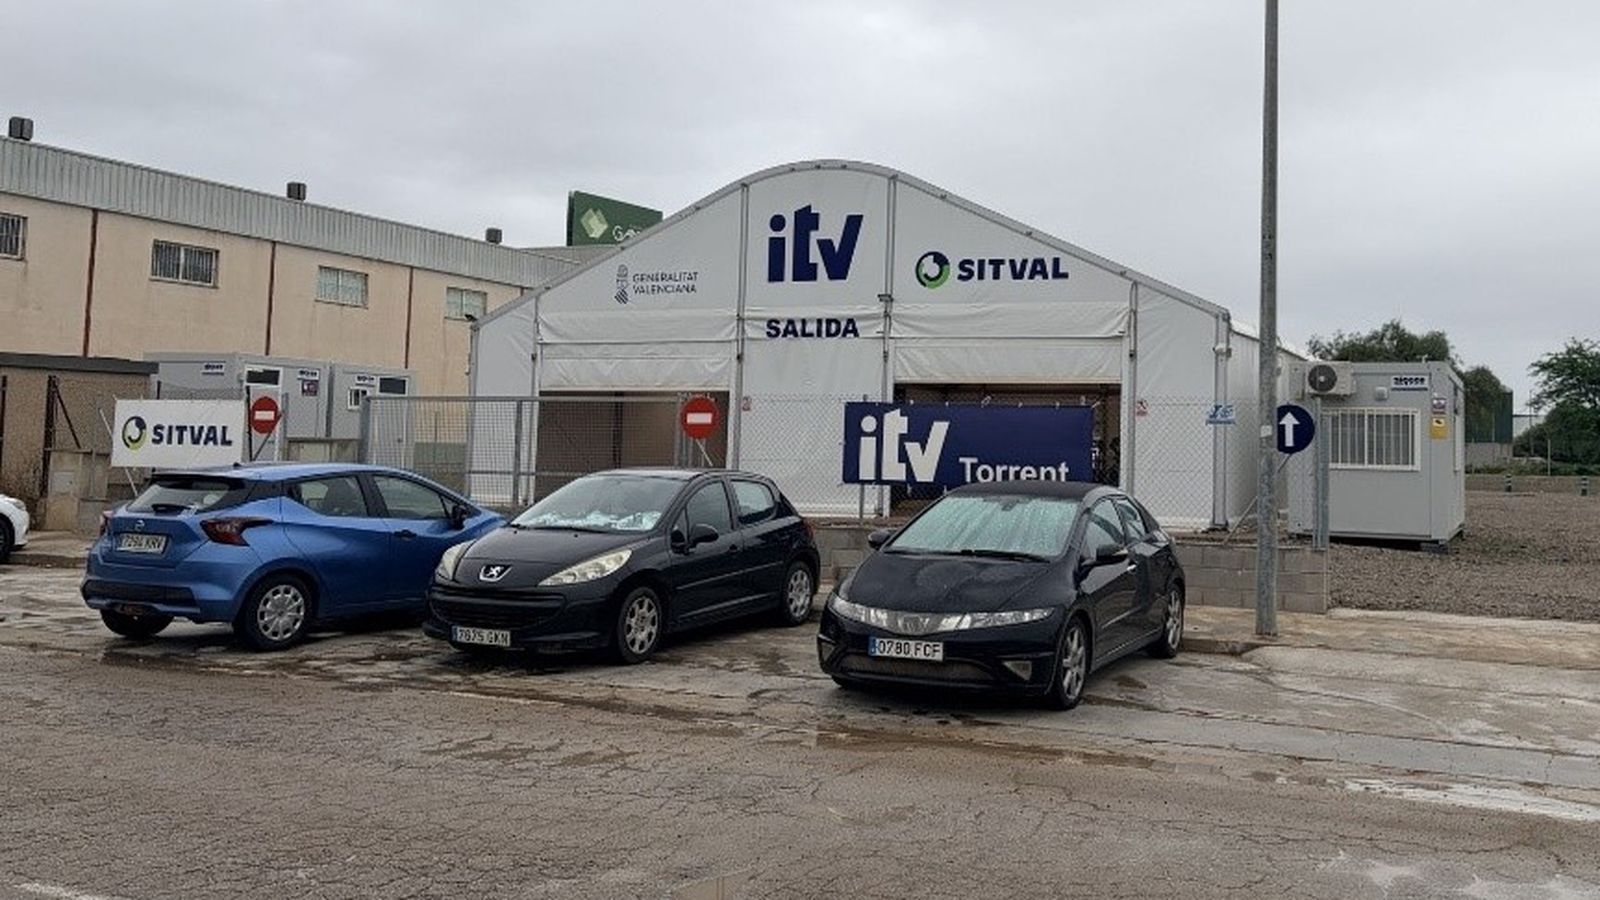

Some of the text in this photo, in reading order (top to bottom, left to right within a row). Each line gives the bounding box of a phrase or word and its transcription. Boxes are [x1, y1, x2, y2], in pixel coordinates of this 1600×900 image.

[767, 204, 864, 283] itv
[632, 271, 698, 283] GENERALITAT
[957, 257, 1069, 281] SITVAL
[632, 284, 697, 295] VALENCIANA
[766, 318, 859, 338] SALIDA
[151, 424, 233, 446] SITVAL
[858, 408, 950, 482] itv
[959, 457, 1069, 482] Torrent
[914, 642, 940, 657] FCF
